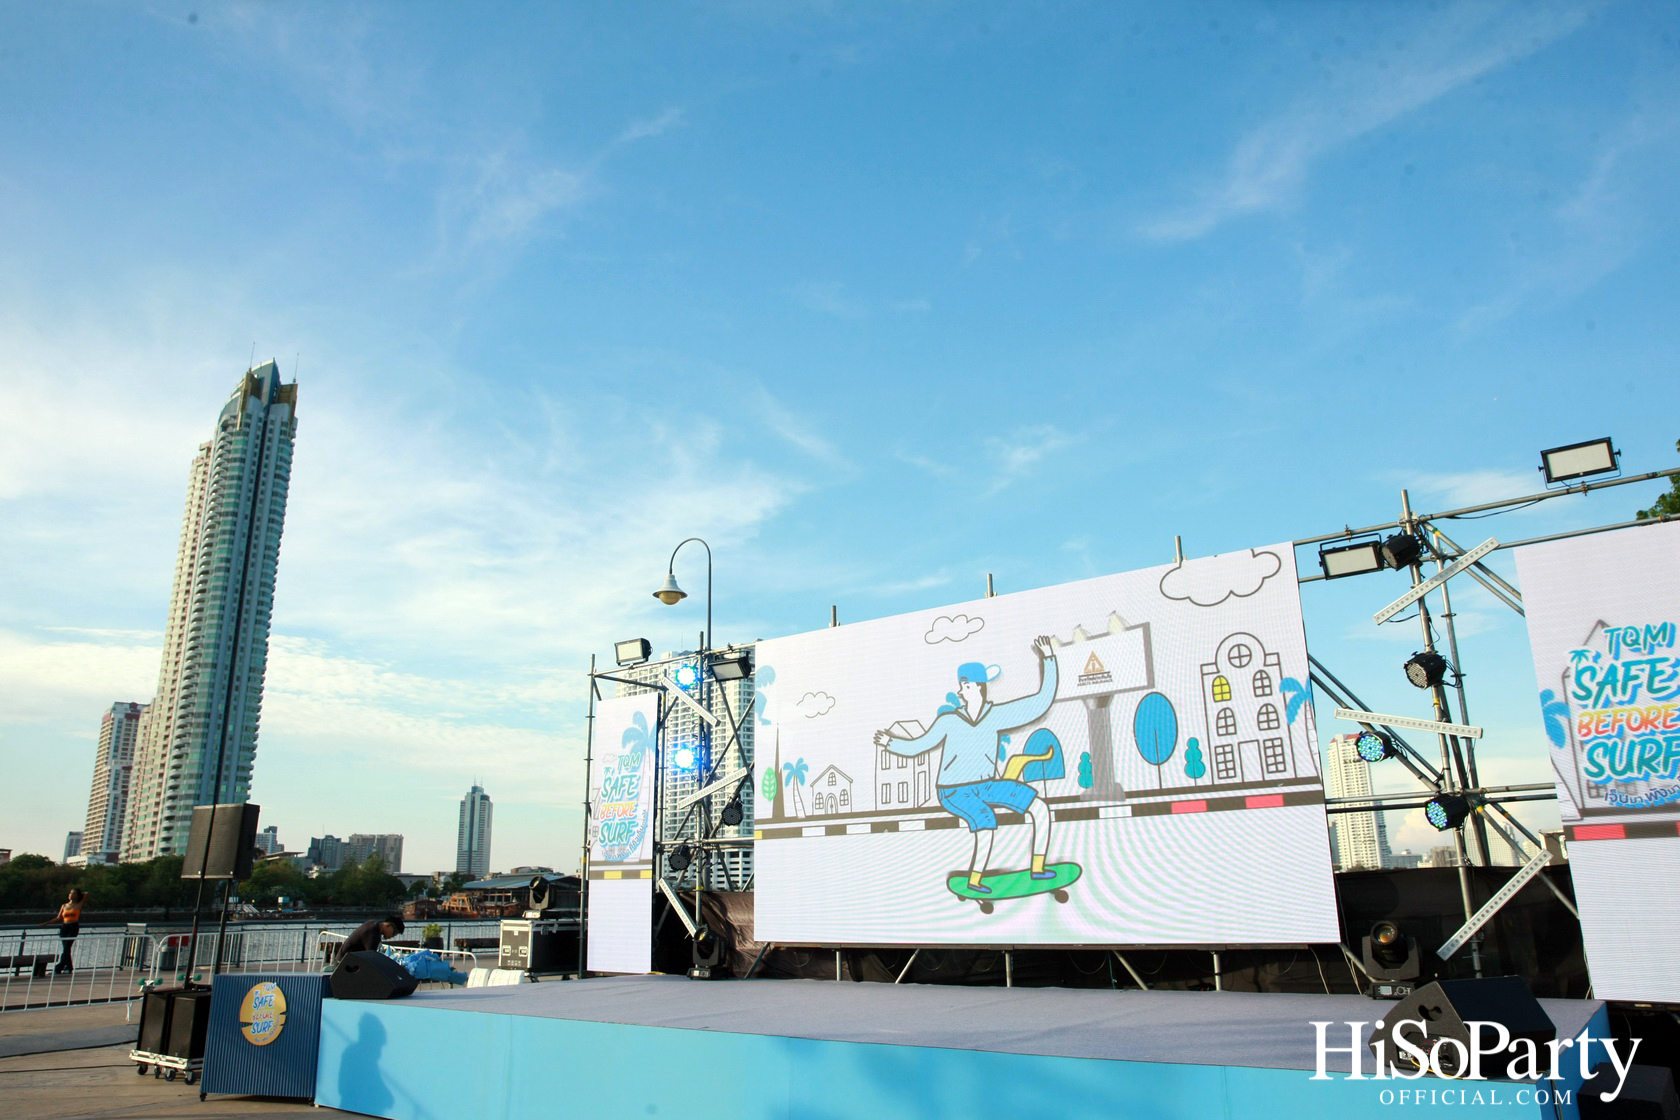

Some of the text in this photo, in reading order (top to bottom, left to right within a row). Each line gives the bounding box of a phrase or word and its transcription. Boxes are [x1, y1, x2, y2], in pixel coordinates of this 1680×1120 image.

[1603, 621, 1669, 655] TQM
[1571, 656, 1672, 709] SAFE
[1577, 703, 1680, 738] BEFORE
[618, 752, 641, 770] TQM
[1584, 735, 1680, 778] SURF
[601, 773, 638, 803] SAFE
[600, 802, 636, 819] BEFORE
[599, 820, 637, 844] SURF
[252, 994, 275, 1010] SAFE
[251, 1020, 274, 1035] SURF
